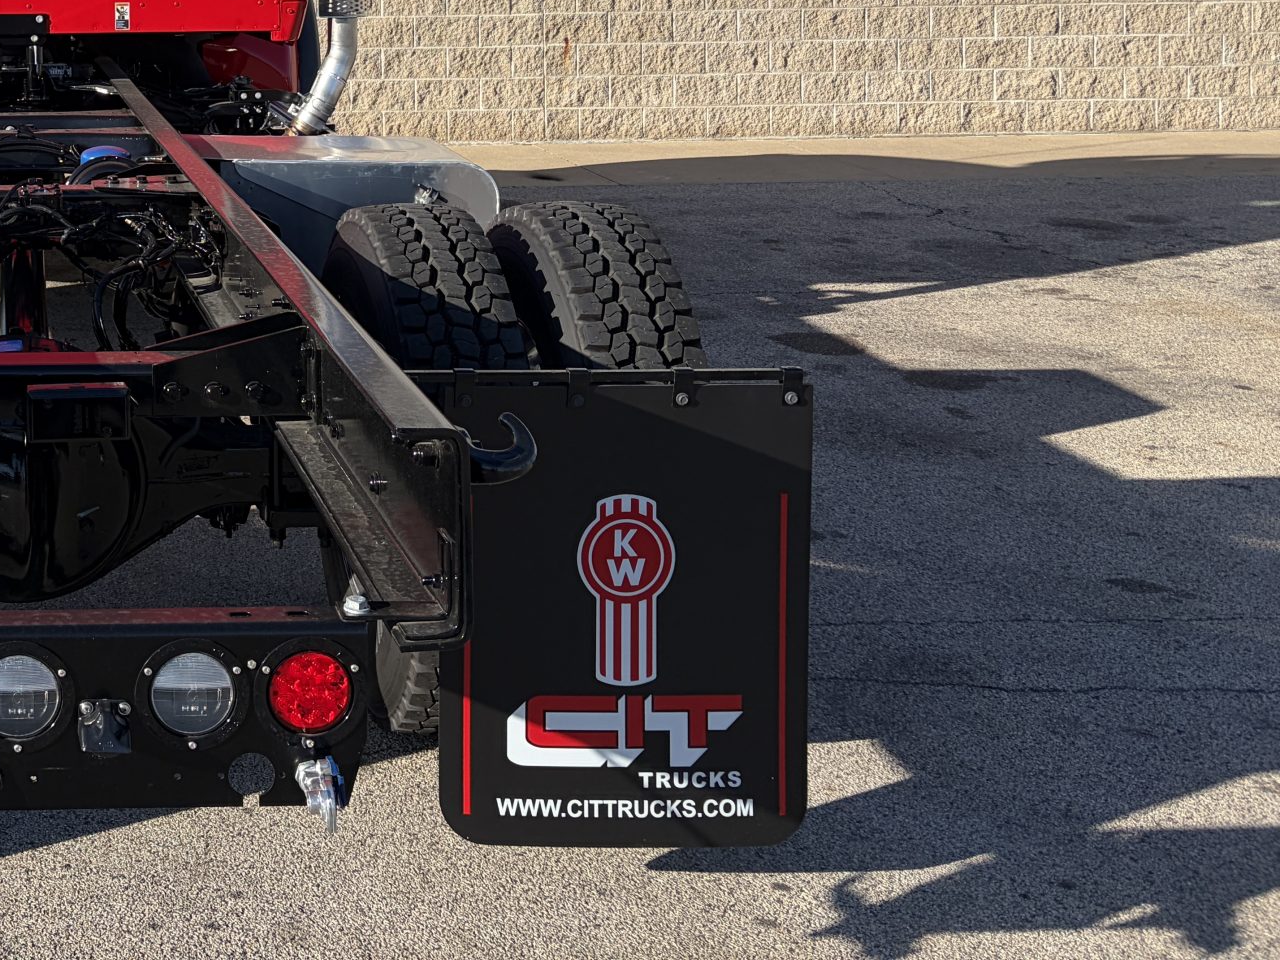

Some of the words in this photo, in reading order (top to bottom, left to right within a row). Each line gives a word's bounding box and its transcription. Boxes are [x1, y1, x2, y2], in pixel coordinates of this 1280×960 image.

[614, 529, 638, 557] K
[606, 558, 646, 586] W
[506, 694, 744, 768] CIT
[638, 771, 742, 788] TRUCKS
[496, 797, 754, 818] WWW.CITTRUCKS.COM
